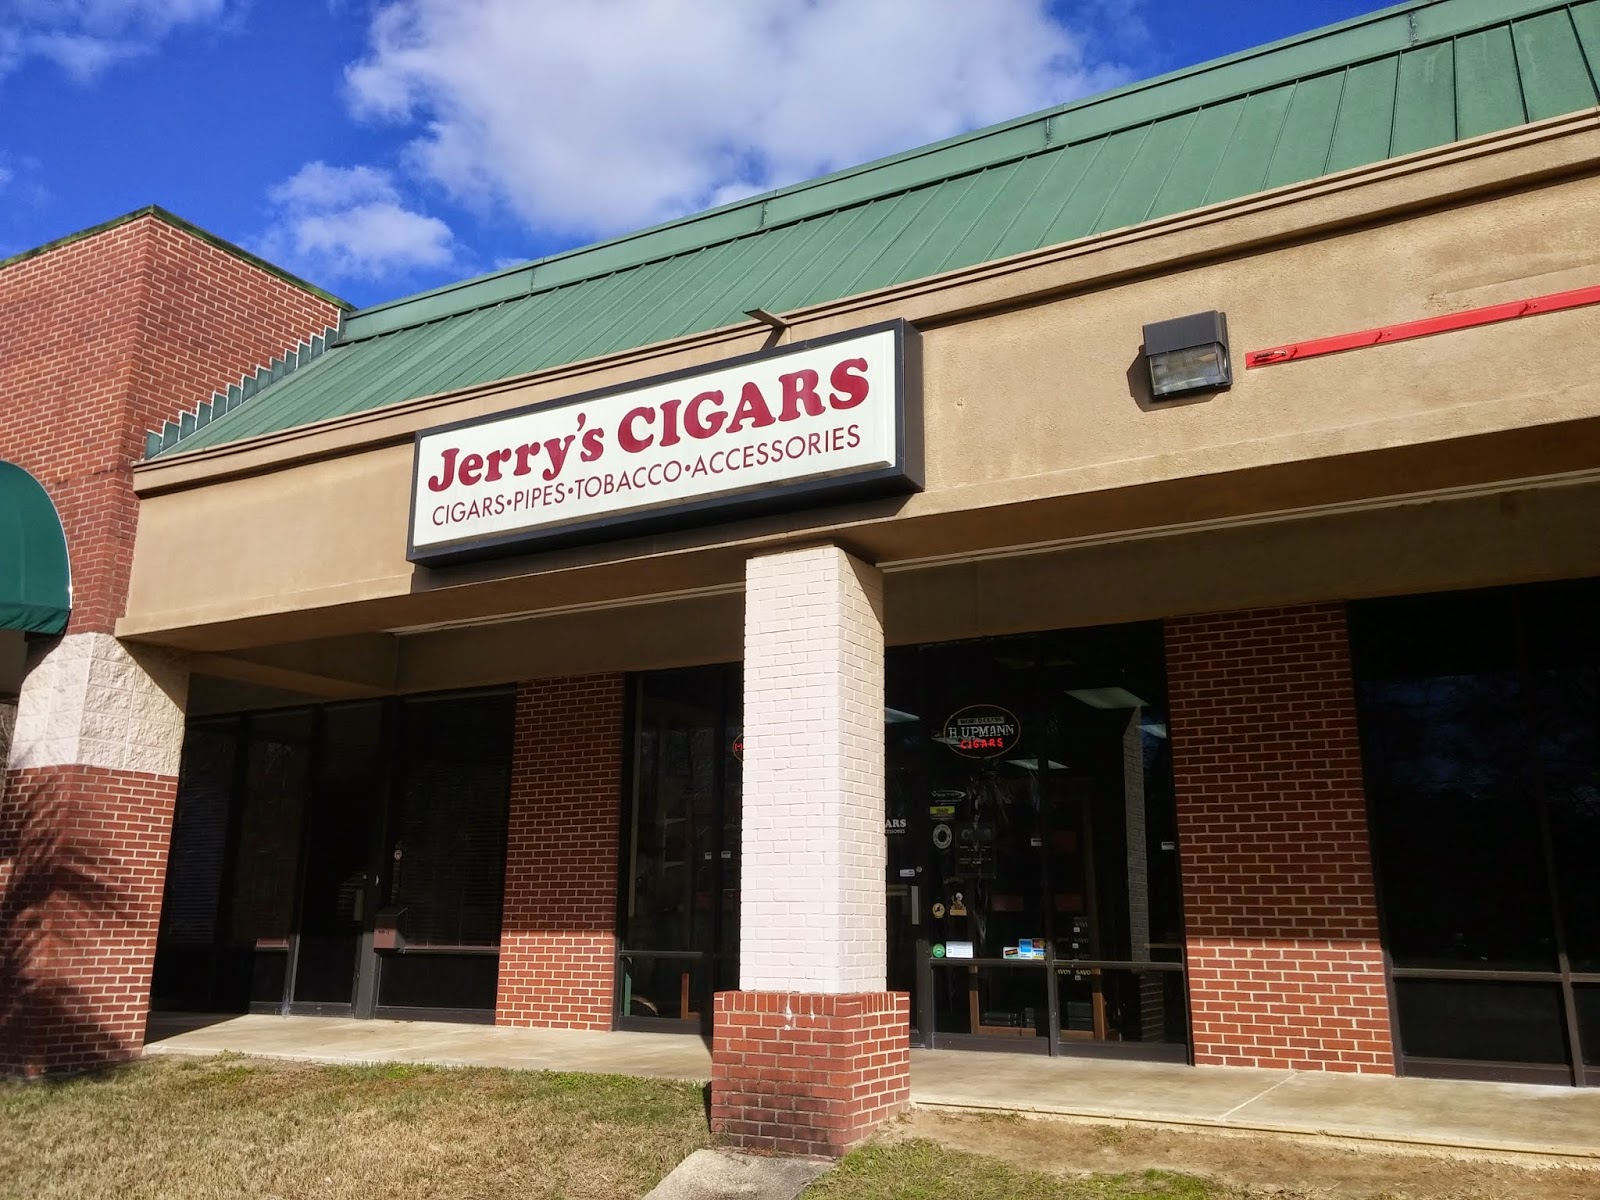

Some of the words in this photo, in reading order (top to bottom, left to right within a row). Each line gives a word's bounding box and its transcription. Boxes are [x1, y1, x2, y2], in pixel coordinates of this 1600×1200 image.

[428, 413, 604, 493] Jerry's
[617, 358, 869, 454] CIGARS
[960, 737, 1004, 750] CIGARS
